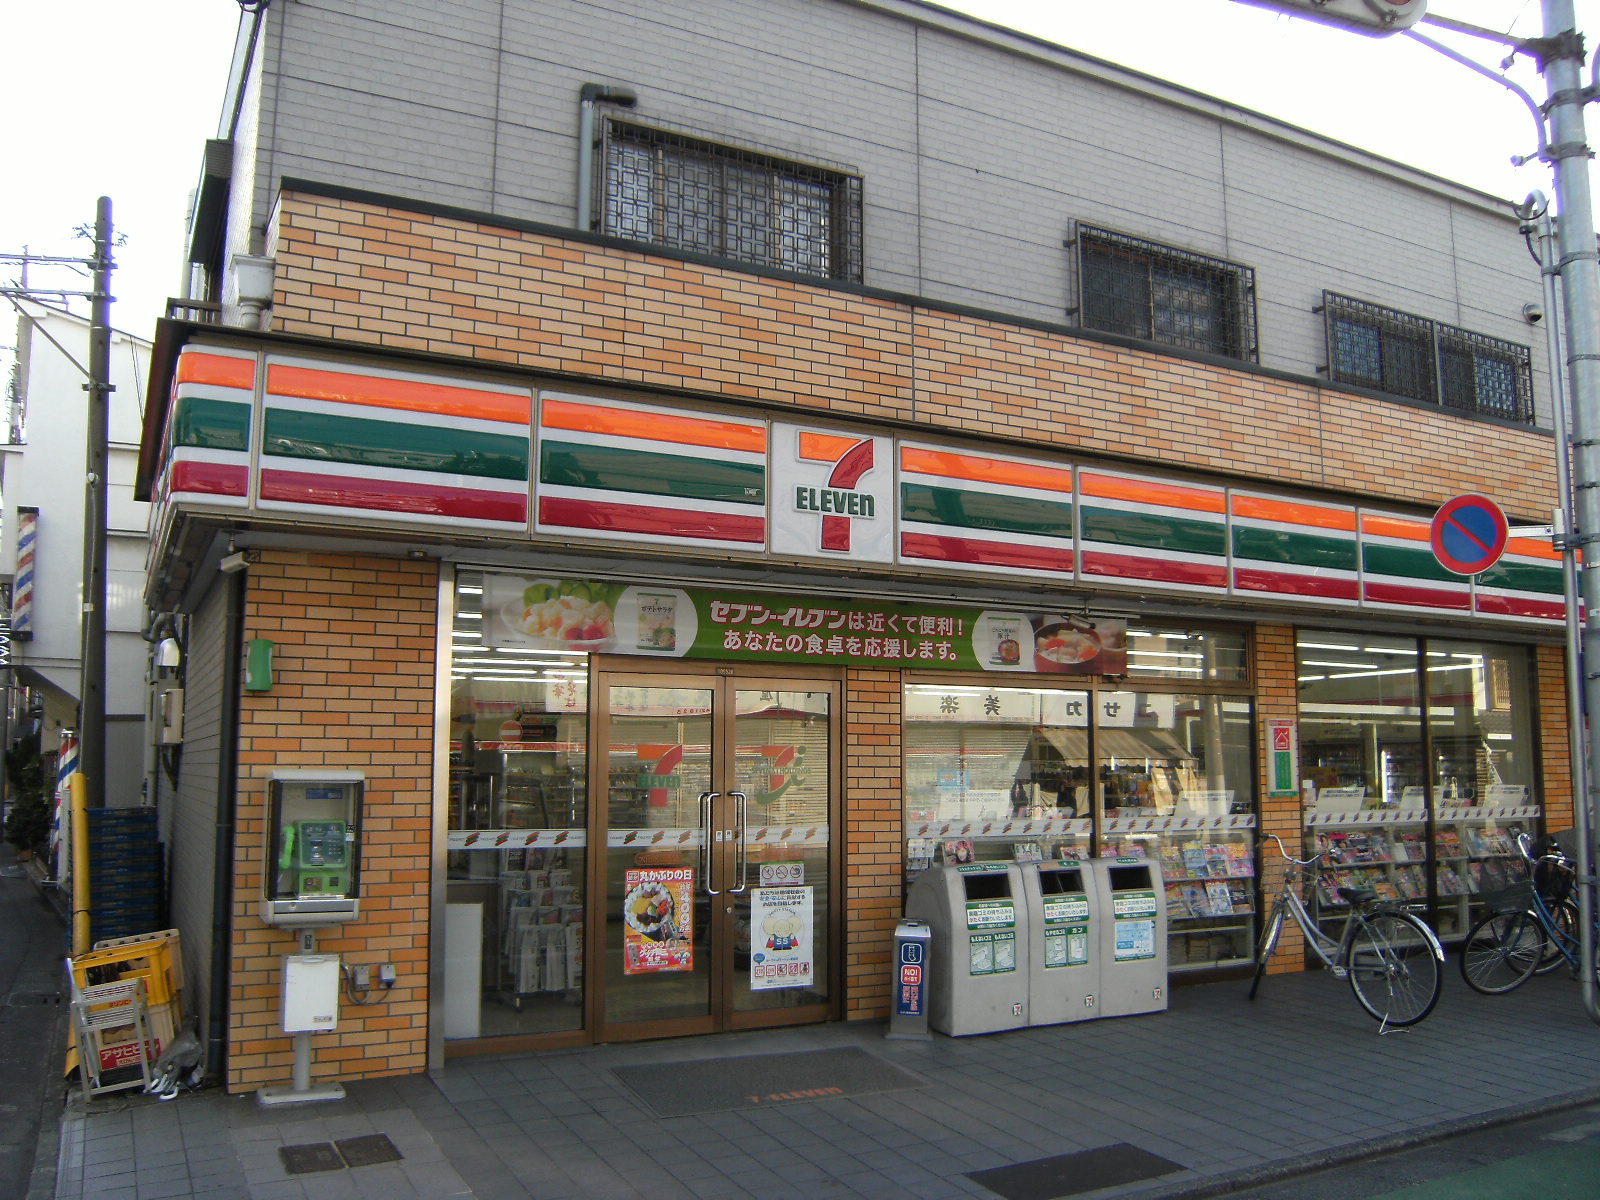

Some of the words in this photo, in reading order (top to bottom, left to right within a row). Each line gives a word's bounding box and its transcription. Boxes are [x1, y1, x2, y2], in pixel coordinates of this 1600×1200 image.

[722, 628, 957, 661] あなたの食卓を応援します。
[639, 869, 692, 881] 丸かぶりの日
[776, 937, 789, 945] SS
[904, 968, 918, 976] NO!
